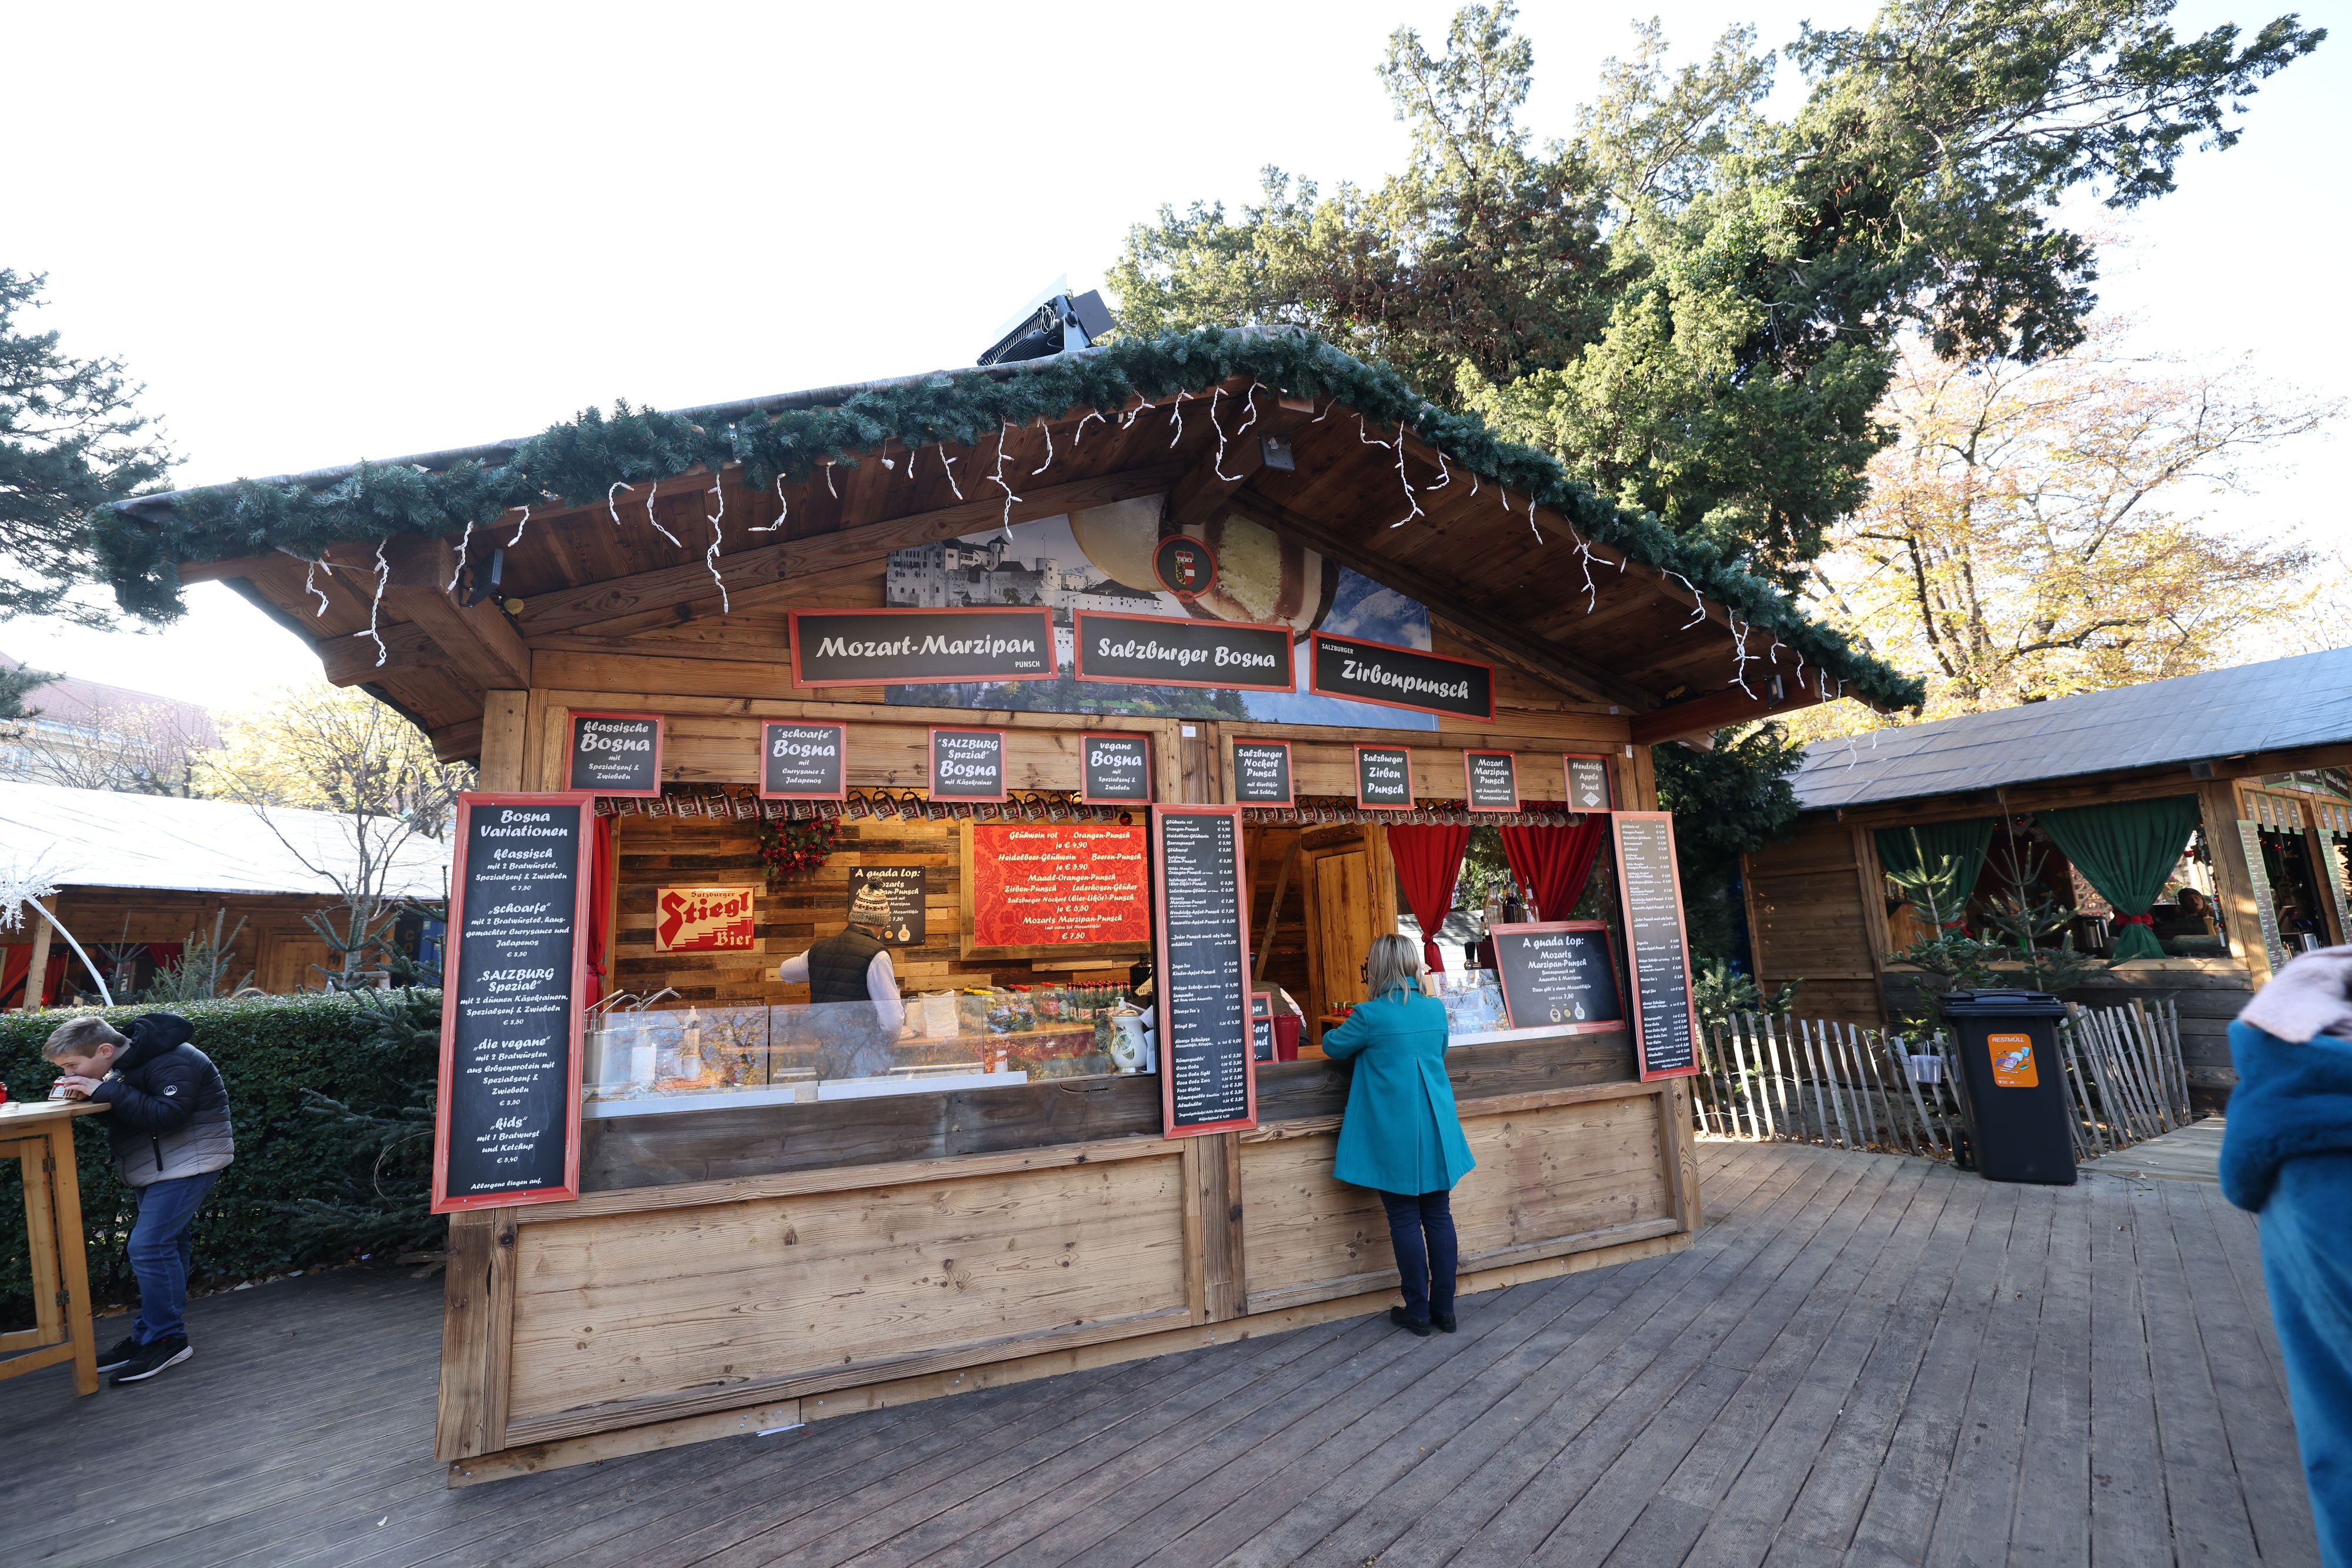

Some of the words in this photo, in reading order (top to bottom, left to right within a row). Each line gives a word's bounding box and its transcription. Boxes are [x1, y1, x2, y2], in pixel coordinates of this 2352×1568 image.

[816, 634, 1035, 658] Mozart-Marzipan
[1322, 643, 1354, 654] SALZBURGER
[1098, 638, 1208, 666] Salzburger
[1214, 646, 1275, 667] Bosna
[1342, 660, 1468, 699] Zirbenpunsch
[584, 721, 649, 733] klassische
[580, 733, 650, 752] Bosna
[1100, 743, 1131, 751] vegane
[773, 740, 835, 757] Bosna
[1091, 751, 1141, 767] Bosna
[1238, 749, 1282, 760] Salzburger
[1364, 754, 1403, 764] Salzburger
[589, 763, 632, 771] Spezialsenf
[940, 760, 996, 777] Bosna
[1244, 758, 1278, 769] Nockerl
[1573, 763, 1602, 771] Hendricks
[1247, 768, 1277, 778] Punsch
[1369, 767, 1400, 778] Zirben
[1474, 767, 1509, 777] Marzipan
[1579, 773, 1598, 781] Apple
[1480, 776, 1505, 785] Punsch
[1368, 783, 1404, 795] Punsch
[500, 810, 550, 823] Bosna
[481, 825, 567, 837] Variationen
[1055, 841, 1062, 850] je
[494, 848, 552, 861] klassisch
[476, 874, 522, 882] Spezialsenf
[855, 869, 864, 877] A
[901, 868, 920, 878] Lop:
[690, 890, 736, 898] Salzburger
[1057, 905, 1063, 914] je
[659, 891, 750, 948] Stiegl
[466, 929, 507, 938] gemachter
[714, 931, 751, 946] Bier
[496, 940, 539, 948] Jalapenos
[1523, 938, 1531, 948] A
[1534, 936, 1563, 950] guada
[1566, 936, 1583, 947] Lop:
[1540, 950, 1572, 959] Mozarts
[466, 1007, 514, 1017] Spezialsenf
[485, 1062, 539, 1072] Erbsenprotein
[483, 1074, 530, 1085] Spezialsenf
[492, 1086, 529, 1095] Zwiebeln
[499, 1130, 539, 1141] Bratwurst
[482, 1145, 498, 1153] und
[500, 1143, 533, 1151] Ketchup
